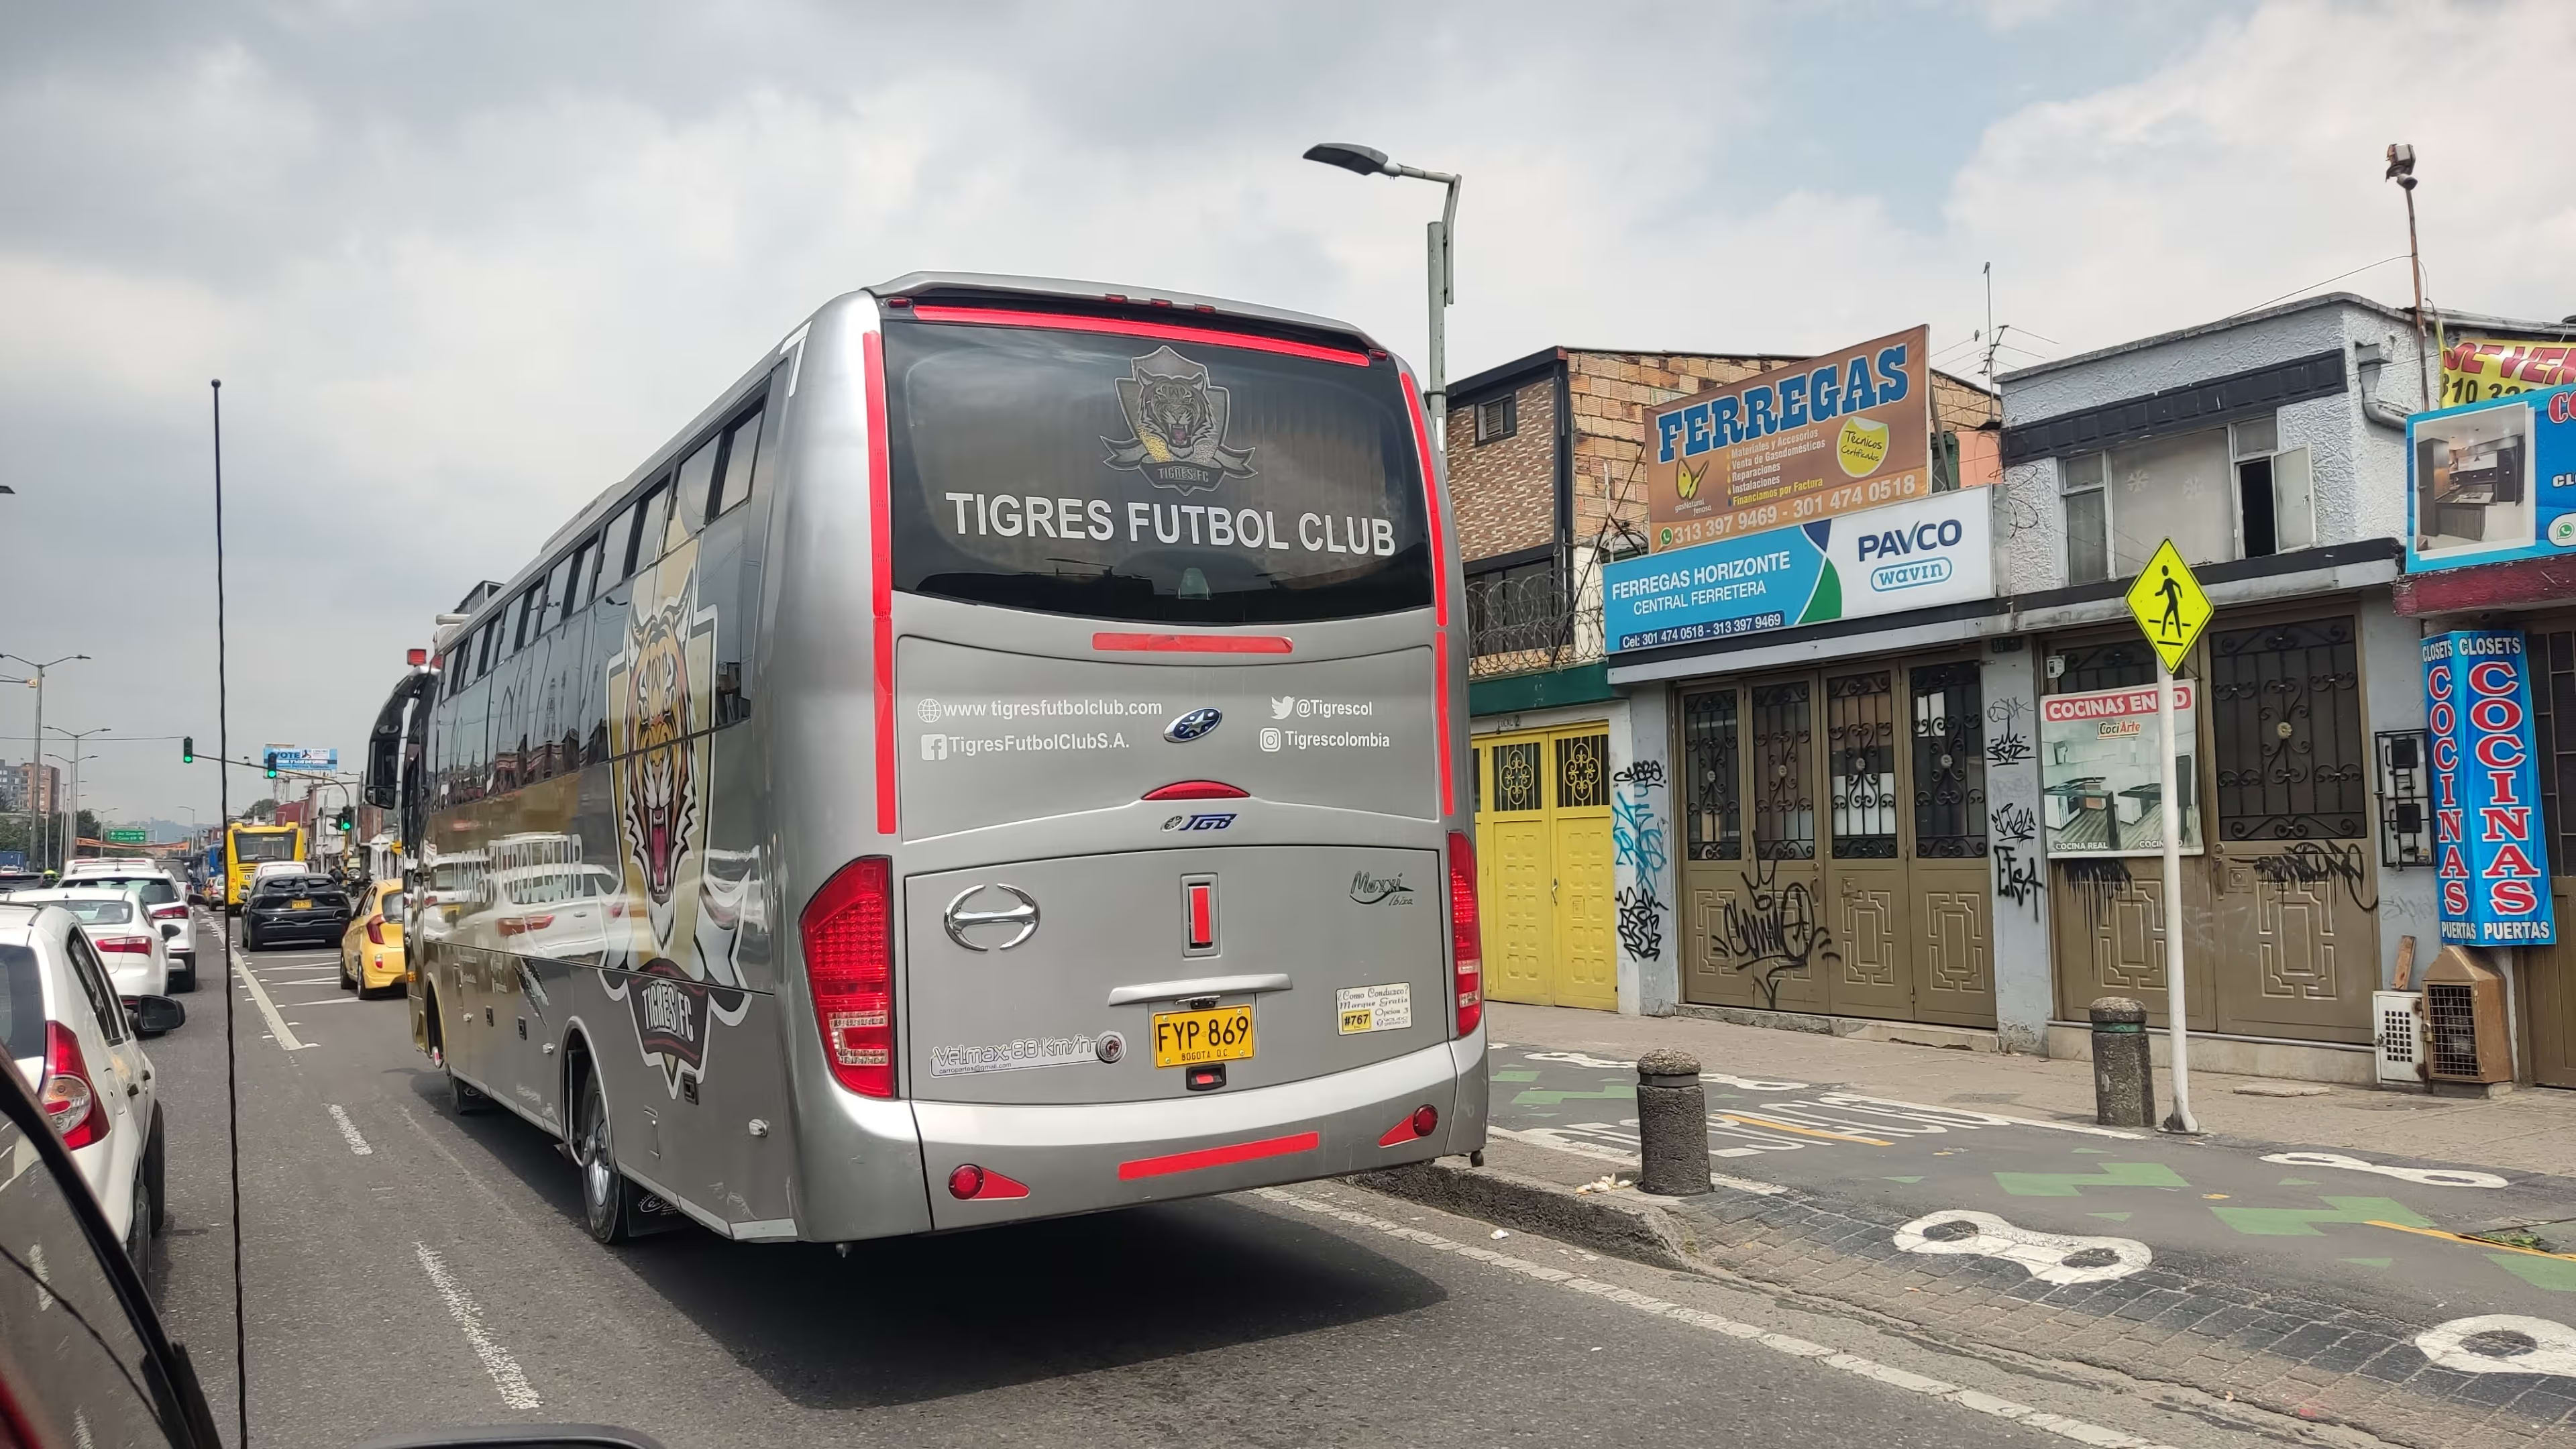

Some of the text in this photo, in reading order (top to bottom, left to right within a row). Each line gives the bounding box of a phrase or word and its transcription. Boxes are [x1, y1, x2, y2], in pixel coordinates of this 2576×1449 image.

[1657, 343, 1910, 464] FERREGAS
[1731, 429, 1818, 459] Materiales y Accesorios
[1845, 430, 1882, 449] Técnicos
[1732, 439, 1825, 470] Venta de Gasodomésticos
[1157, 466, 1209, 482] TIGRES FC
[1732, 463, 1780, 482] Reparaciones
[1732, 475, 1780, 494] Instalaciones
[1733, 489, 1778, 506] Financiamos
[1780, 485, 1791, 497] por
[1674, 523, 1701, 544] 313
[1705, 516, 1733, 538] 397
[1737, 505, 1778, 531] 9469
[1793, 499, 1823, 519] 301
[1829, 486, 1863, 510] 474
[1868, 475, 1915, 502] 0518
[945, 492, 1397, 557] TIGRES FUTBOL CLUB
[1858, 519, 1962, 562] PAVCO
[1612, 551, 1791, 600] FERREGAS HORIZONTE
[1878, 563, 1944, 586] wavin
[1633, 580, 1766, 616] CENTRAL FERRETERA
[1622, 635, 1640, 649] Cel:
[1642, 633, 1658, 645] 301
[1661, 629, 1678, 643] 474
[1680, 625, 1704, 639] 0518
[1713, 621, 1731, 635] 313
[1733, 617, 1752, 631] 397
[1755, 613, 1781, 629] 9469
[2422, 639, 2453, 663] CLOSETS
[2459, 637, 2521, 655] CLOSETS
[944, 699, 1163, 720] www tigresfutbolclub.com
[1296, 699, 1373, 718] @Tigrescol
[2049, 696, 2125, 719] COCINAS
[2129, 694, 2157, 712] EN
[2099, 720, 2141, 735] CociArte
[948, 732, 1130, 757] TigresFutbolClubS.A.
[1285, 730, 1390, 750] Tigrescolombia
[2428, 665, 2469, 915] COCINAS
[2469, 661, 2542, 916] COCINAS
[2055, 841, 2108, 850] COCINA REAL
[2139, 839, 2163, 849] COCIN
[451, 833, 584, 903] TIGRES FUTBOL CLUB
[2441, 921, 2476, 939] PUERTAS
[2483, 921, 2550, 940] PUERTAS
[642, 984, 694, 1042] TIGRES FC
[1340, 996, 1408, 1010] Marque Gratis
[1344, 1014, 1369, 1026] #767
[1158, 1016, 1248, 1052] FYP 869
[1011, 1039, 1039, 1060] 80
[1041, 1034, 1091, 1057] Km/h
[1181, 1050, 1211, 1061] BOGOTA
